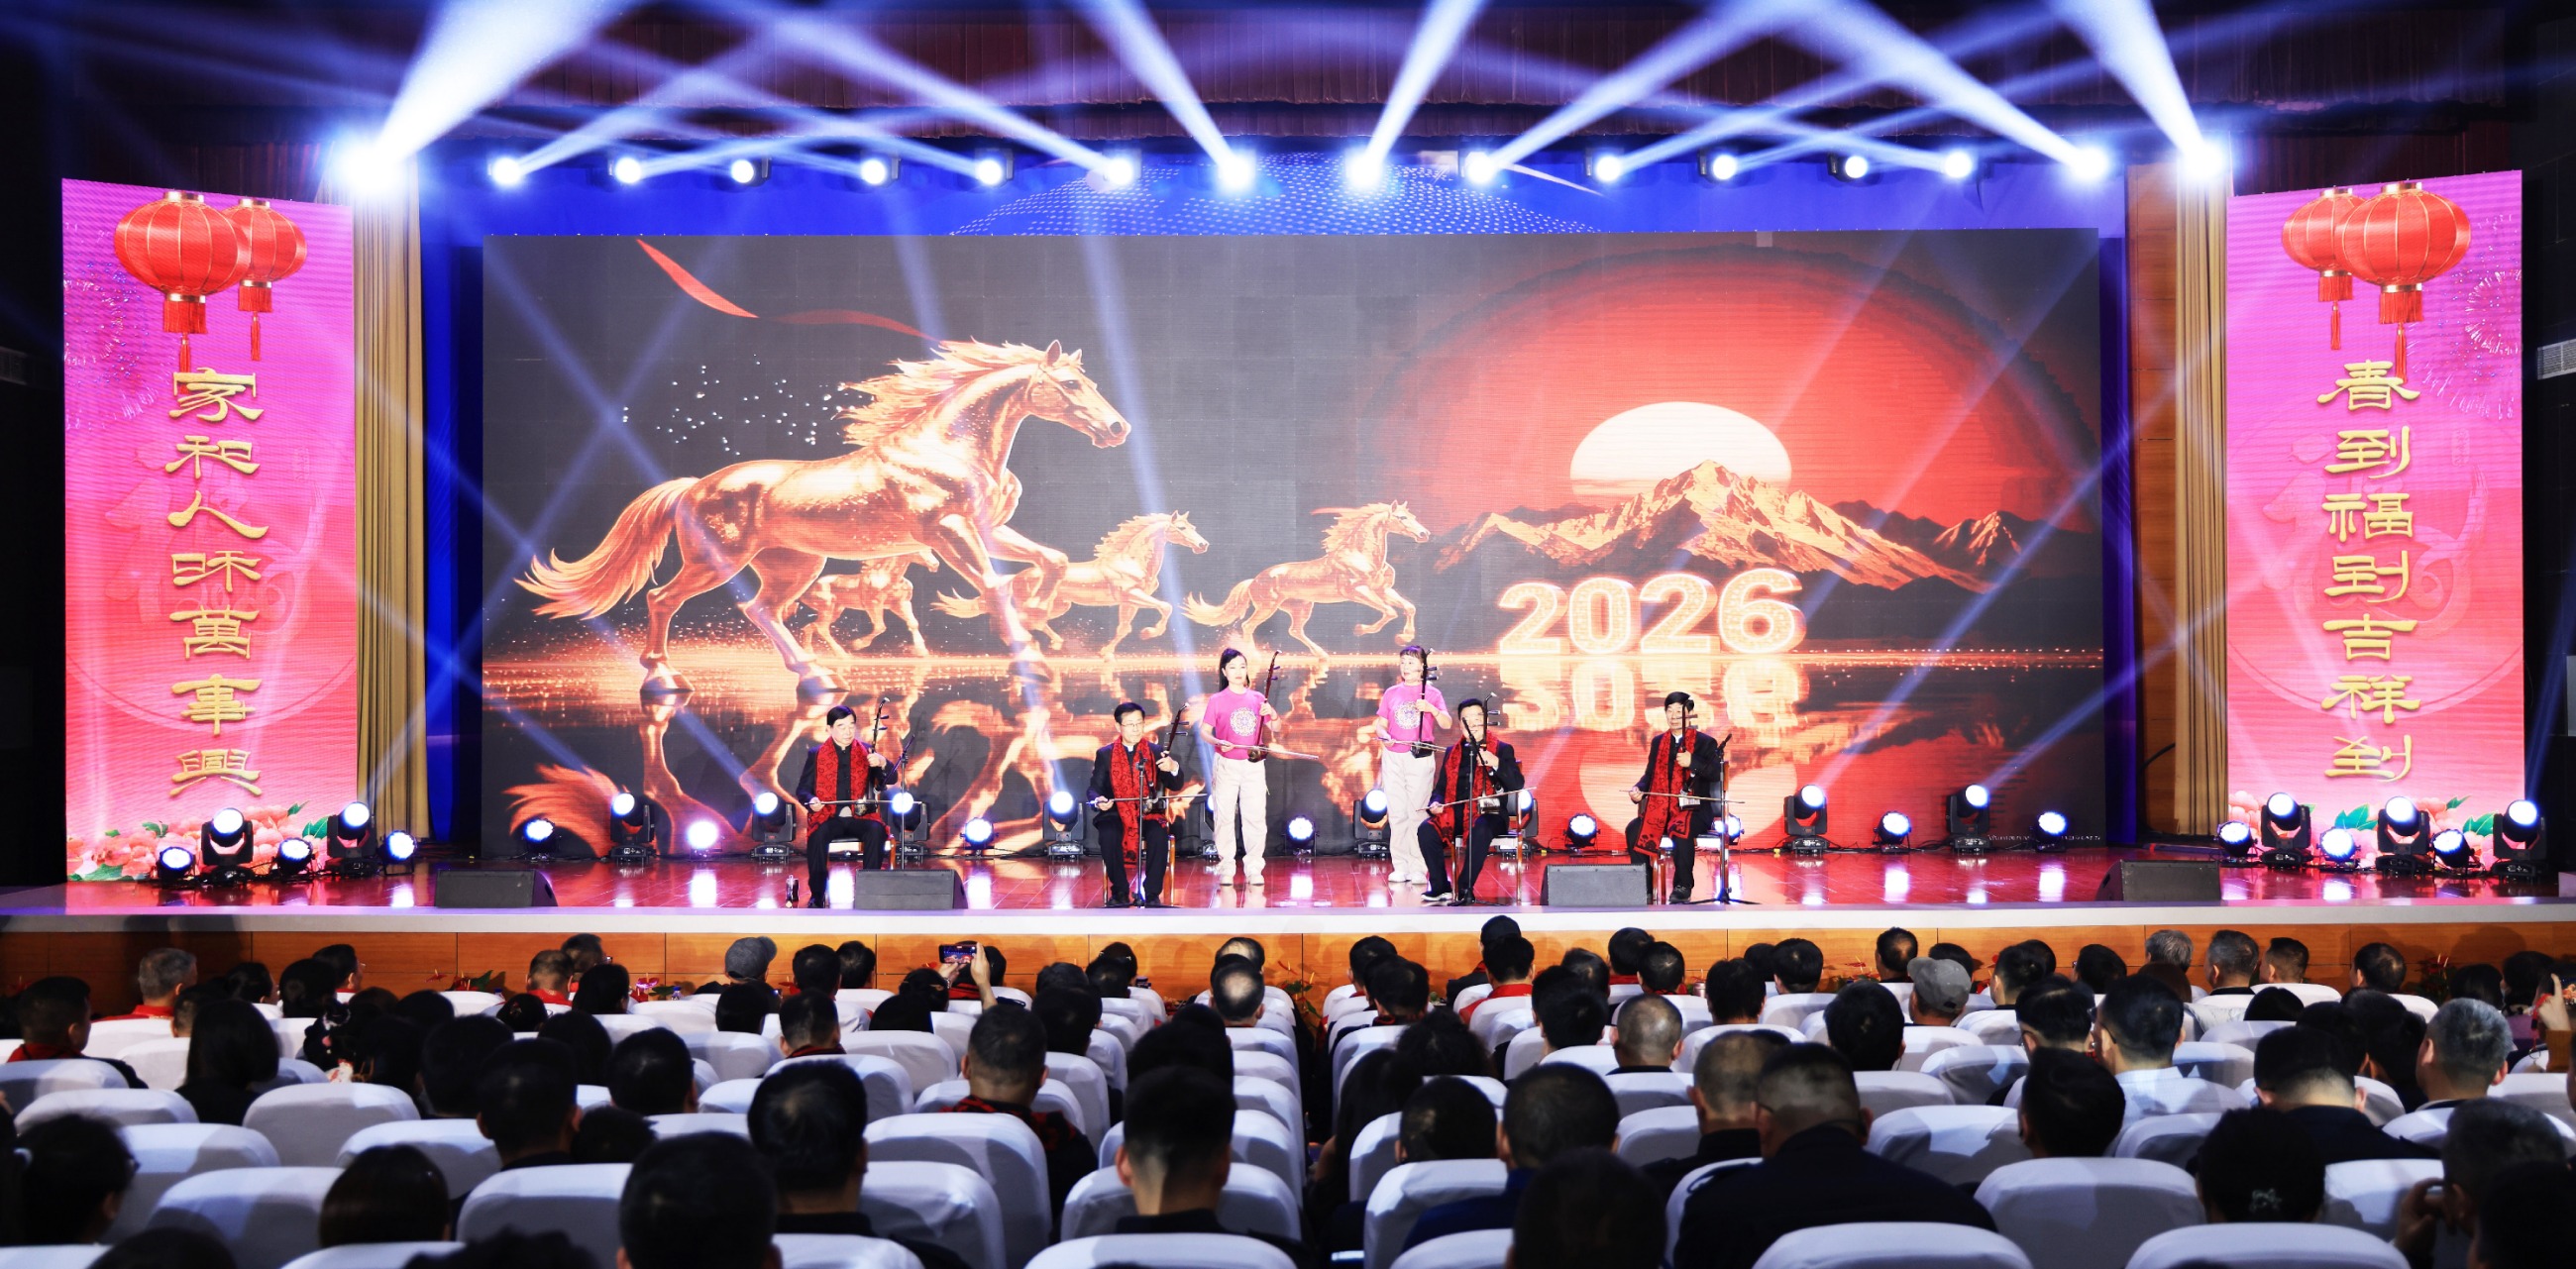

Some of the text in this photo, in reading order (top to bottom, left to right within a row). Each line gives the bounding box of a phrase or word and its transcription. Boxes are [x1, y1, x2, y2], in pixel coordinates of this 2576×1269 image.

[1498, 568, 1807, 655] 2026
[2316, 359, 2420, 782] 春到福到吉祥到
